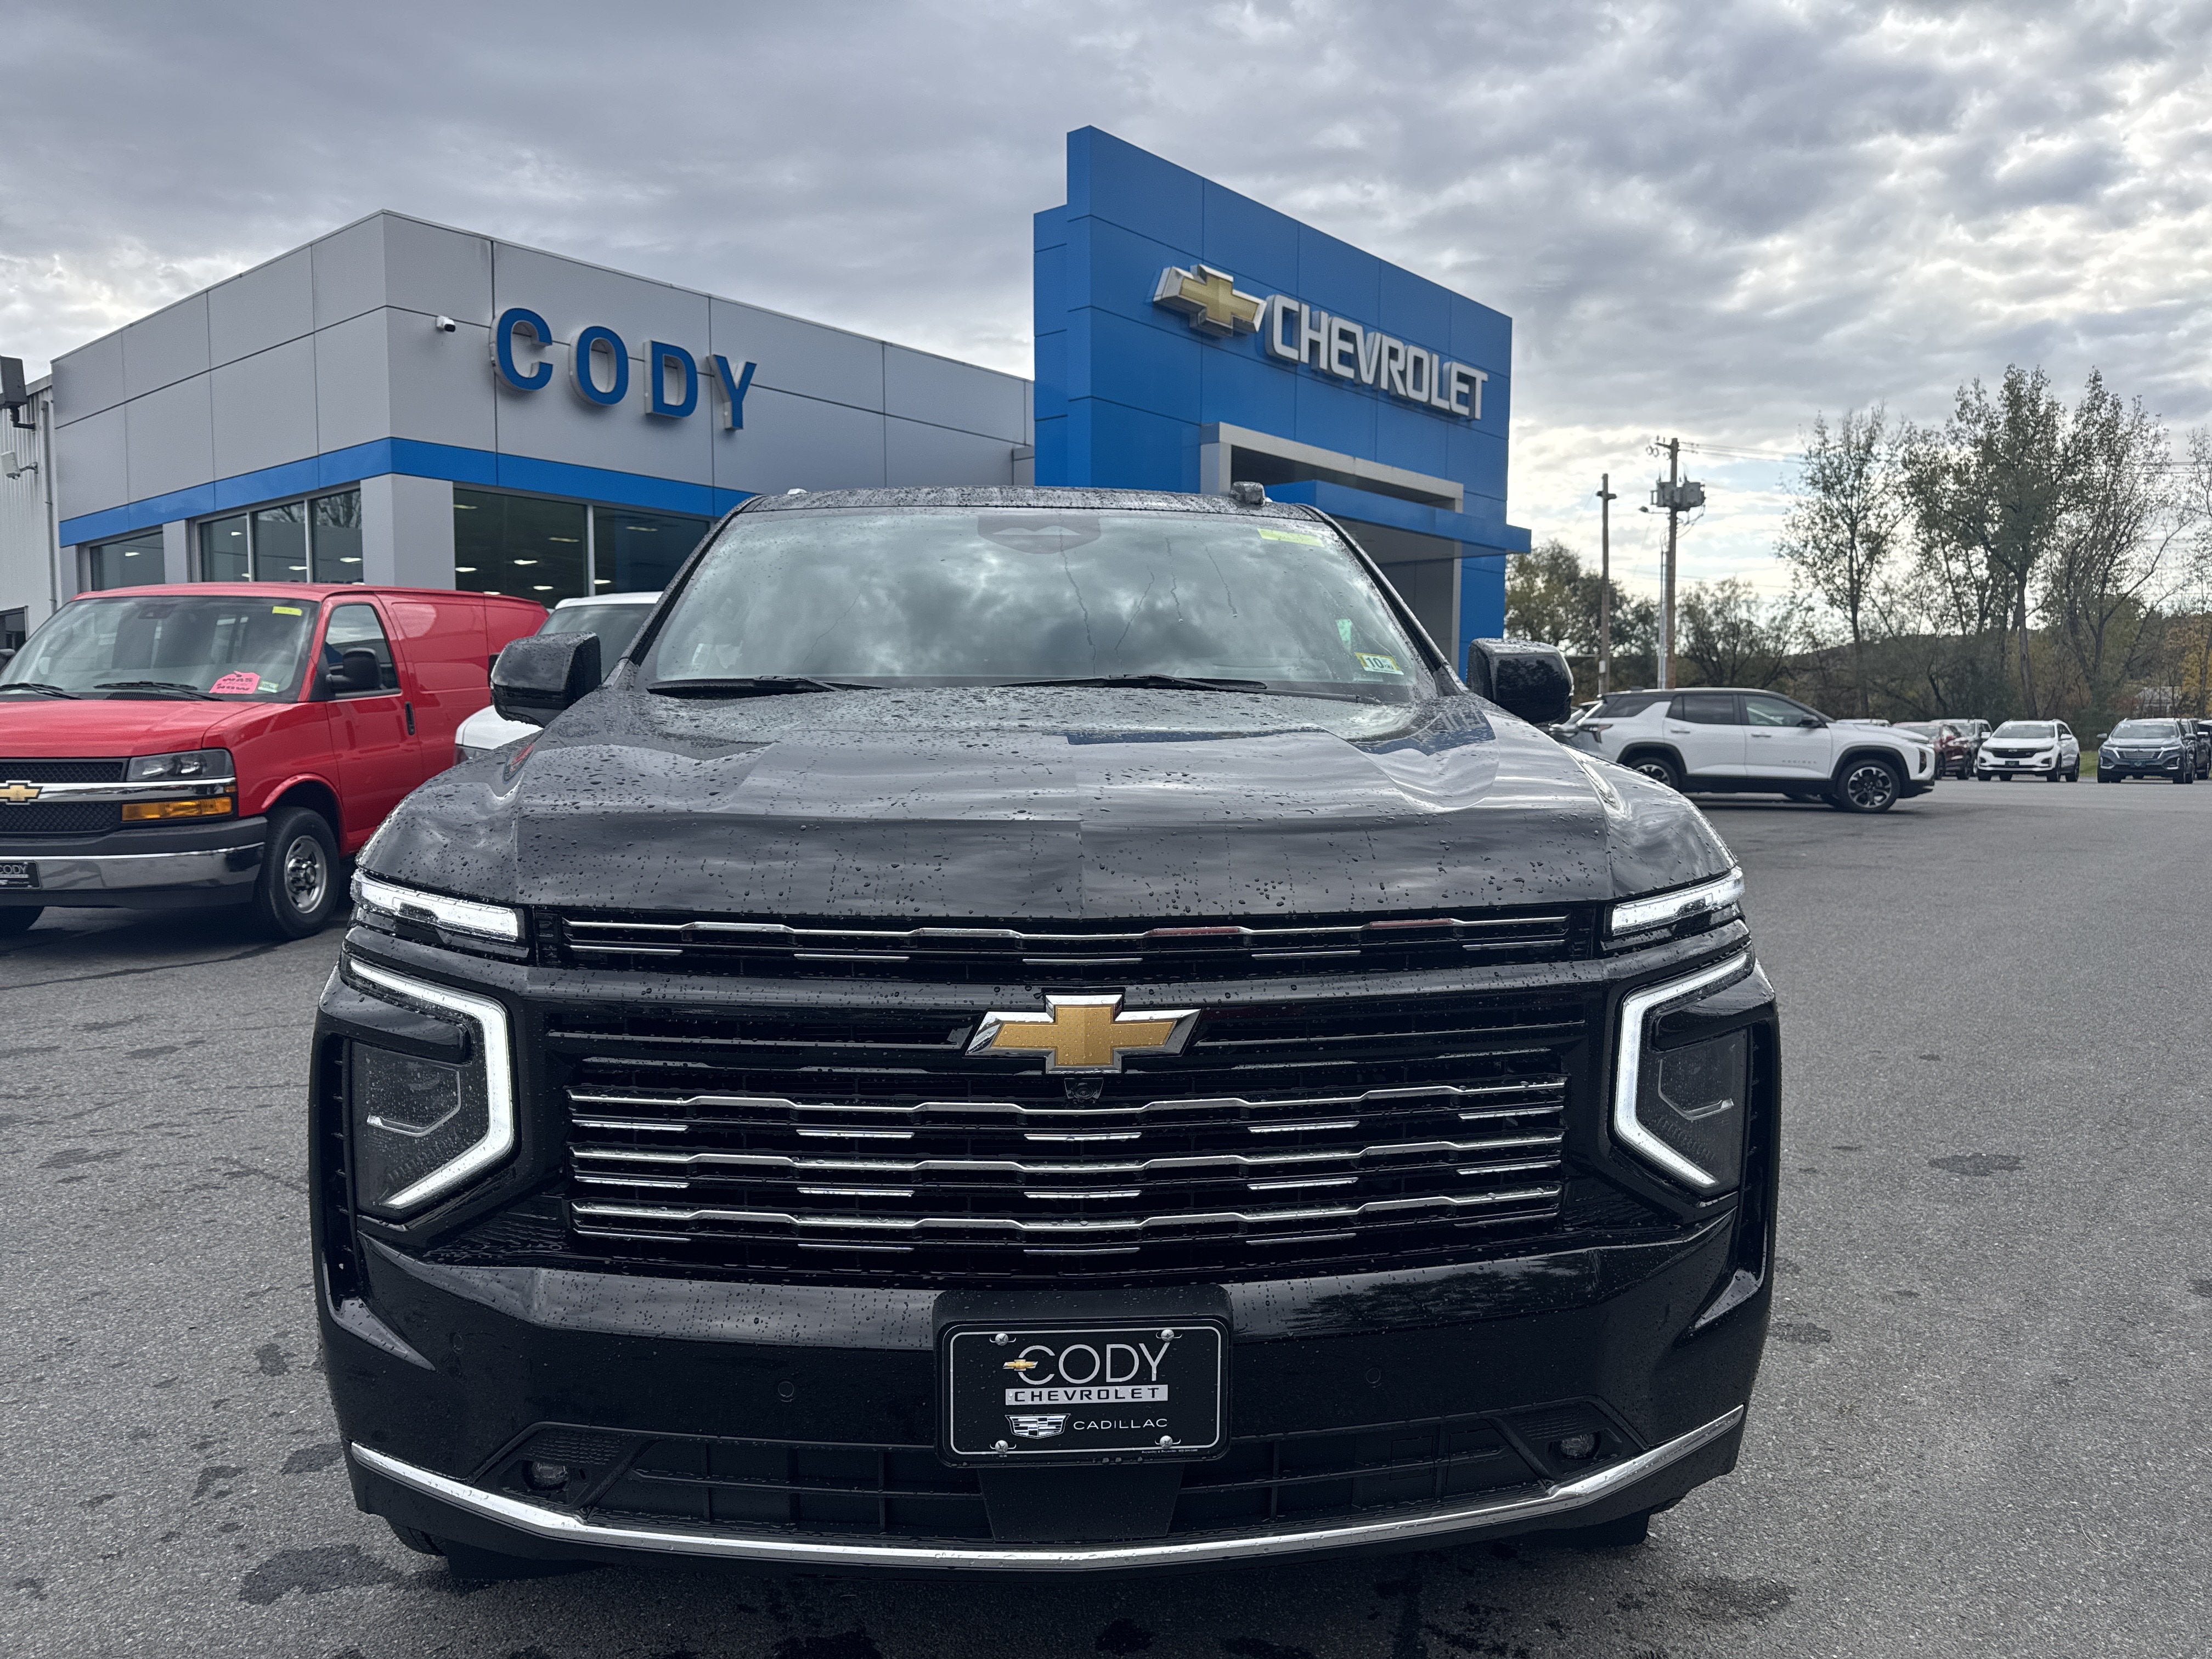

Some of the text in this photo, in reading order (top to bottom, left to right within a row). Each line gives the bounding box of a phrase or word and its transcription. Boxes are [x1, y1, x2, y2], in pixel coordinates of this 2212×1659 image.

[492, 307, 757, 430] CODY
[1266, 294, 1488, 421] CHEVROLET
[1365, 657, 1385, 668] 10
[1018, 1342, 1170, 1385] CODY
[1014, 1387, 1160, 1403] CHEVROLET
[1073, 1418, 1168, 1431] CADILLAC
